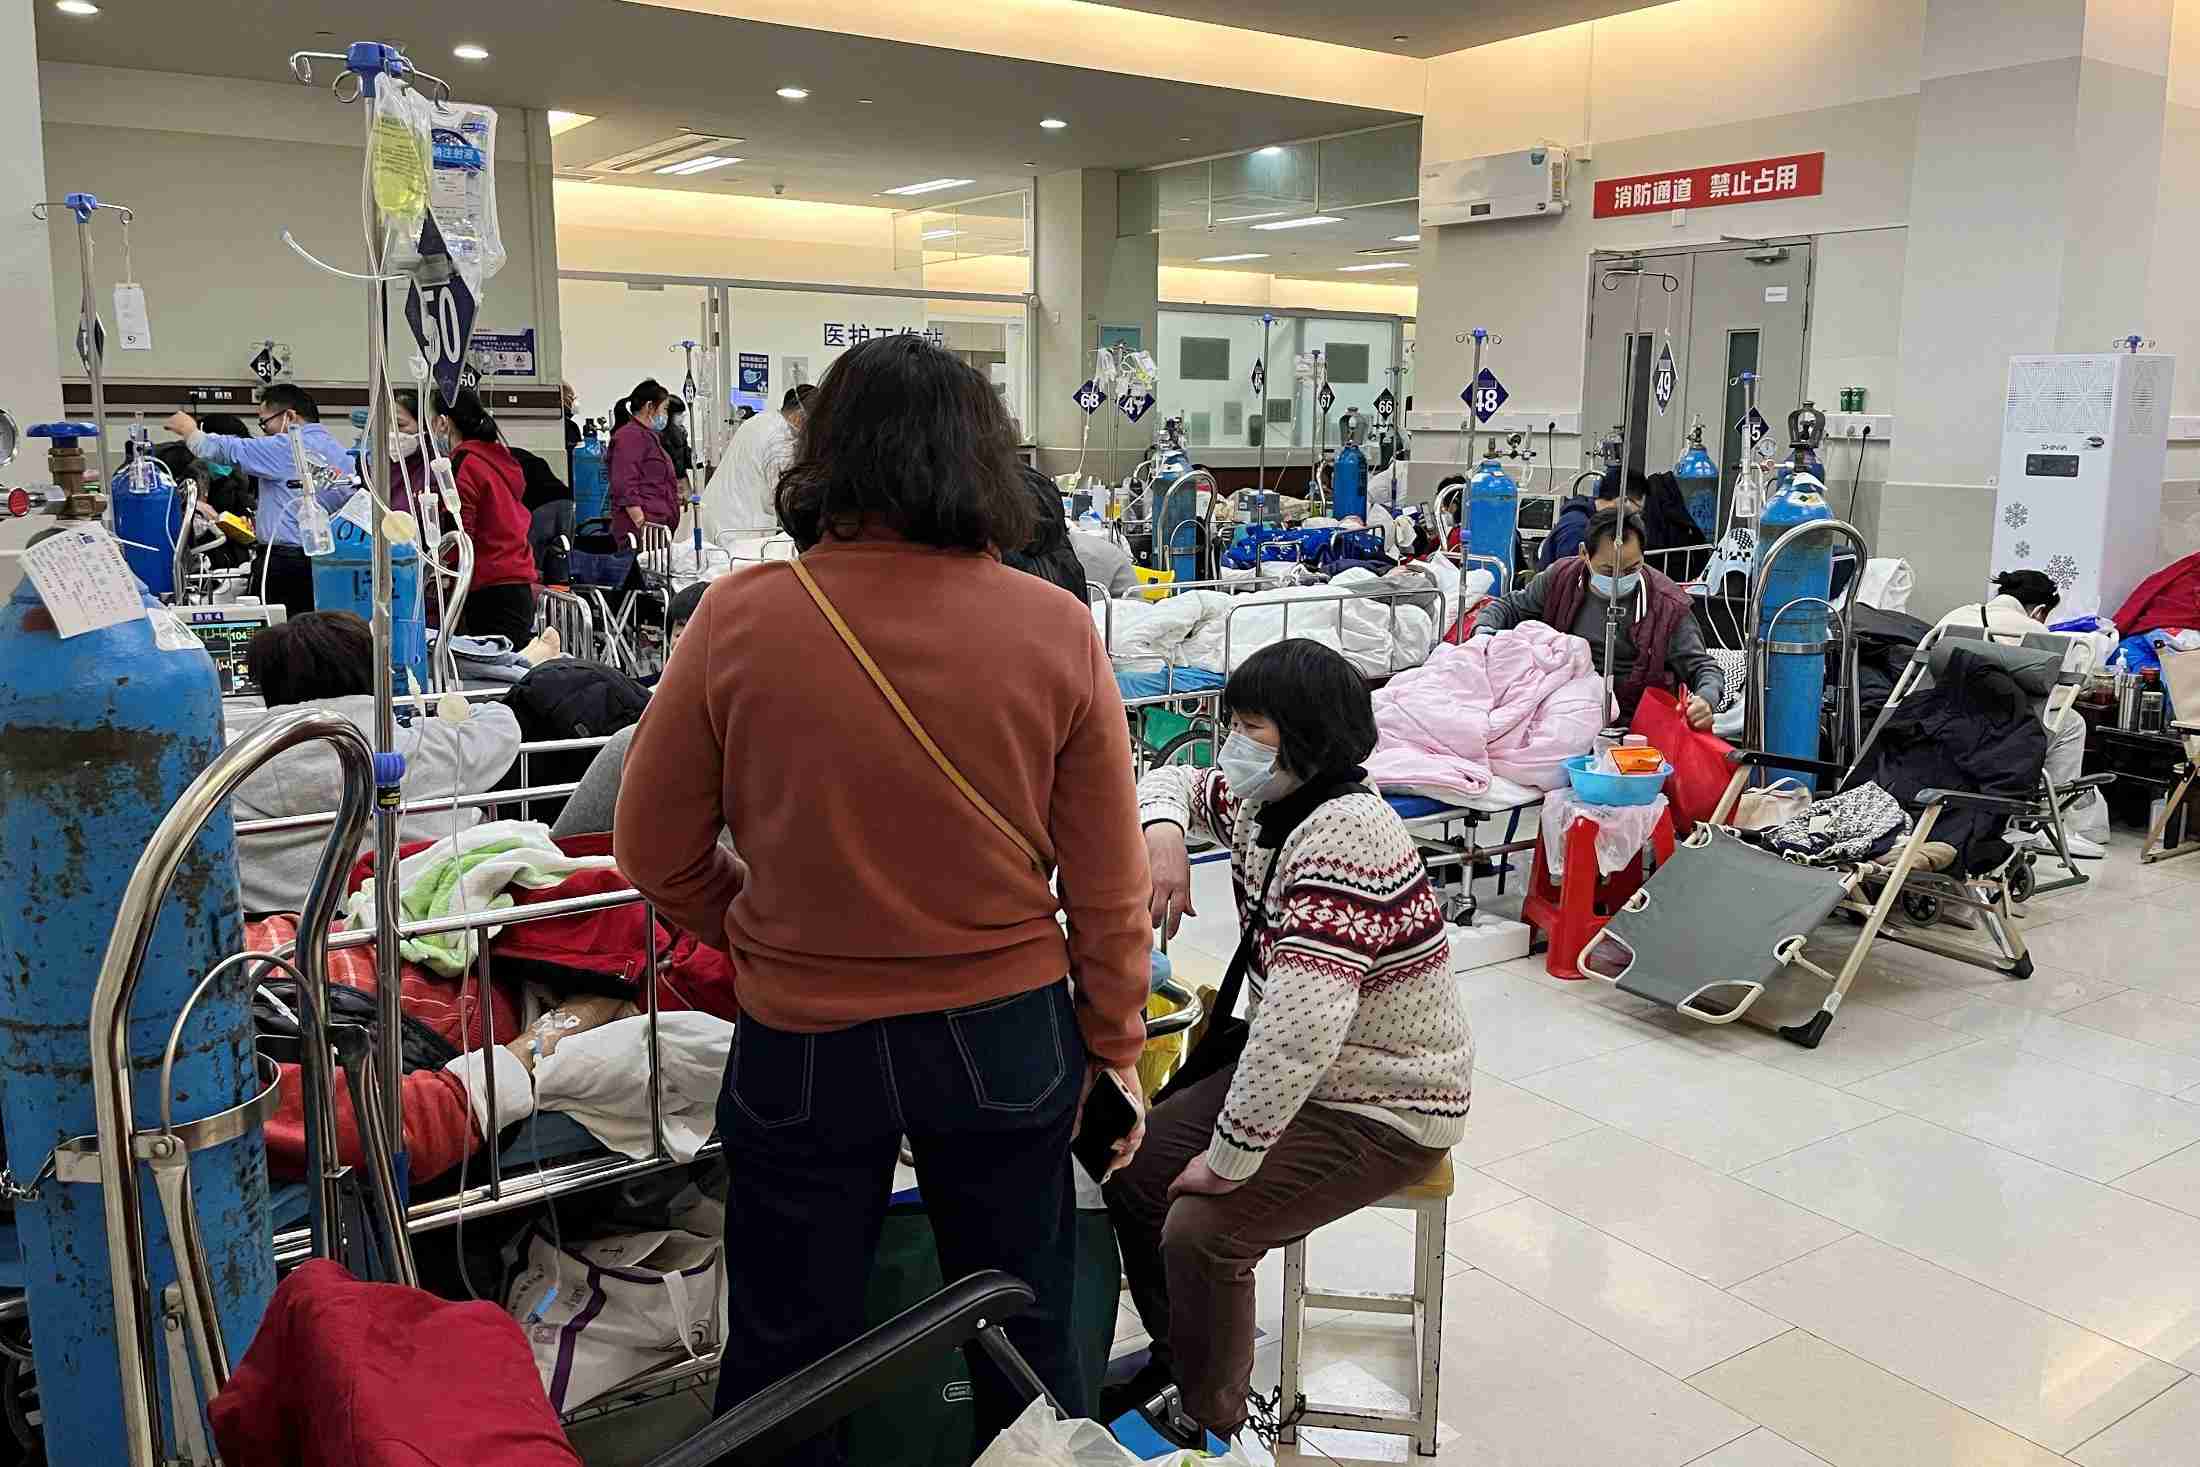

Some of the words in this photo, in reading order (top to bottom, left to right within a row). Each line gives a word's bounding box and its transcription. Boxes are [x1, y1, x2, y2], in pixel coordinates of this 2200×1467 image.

[1614, 178, 1692, 209] 消防通道
[1709, 164, 1798, 198] 禁止占用
[422, 286, 461, 364] 50
[1656, 371, 1671, 401] 49
[1080, 393, 1099, 408] 68
[1320, 394, 1331, 409] 67
[1378, 400, 1393, 414] 66
[231, 631, 247, 641] 104
